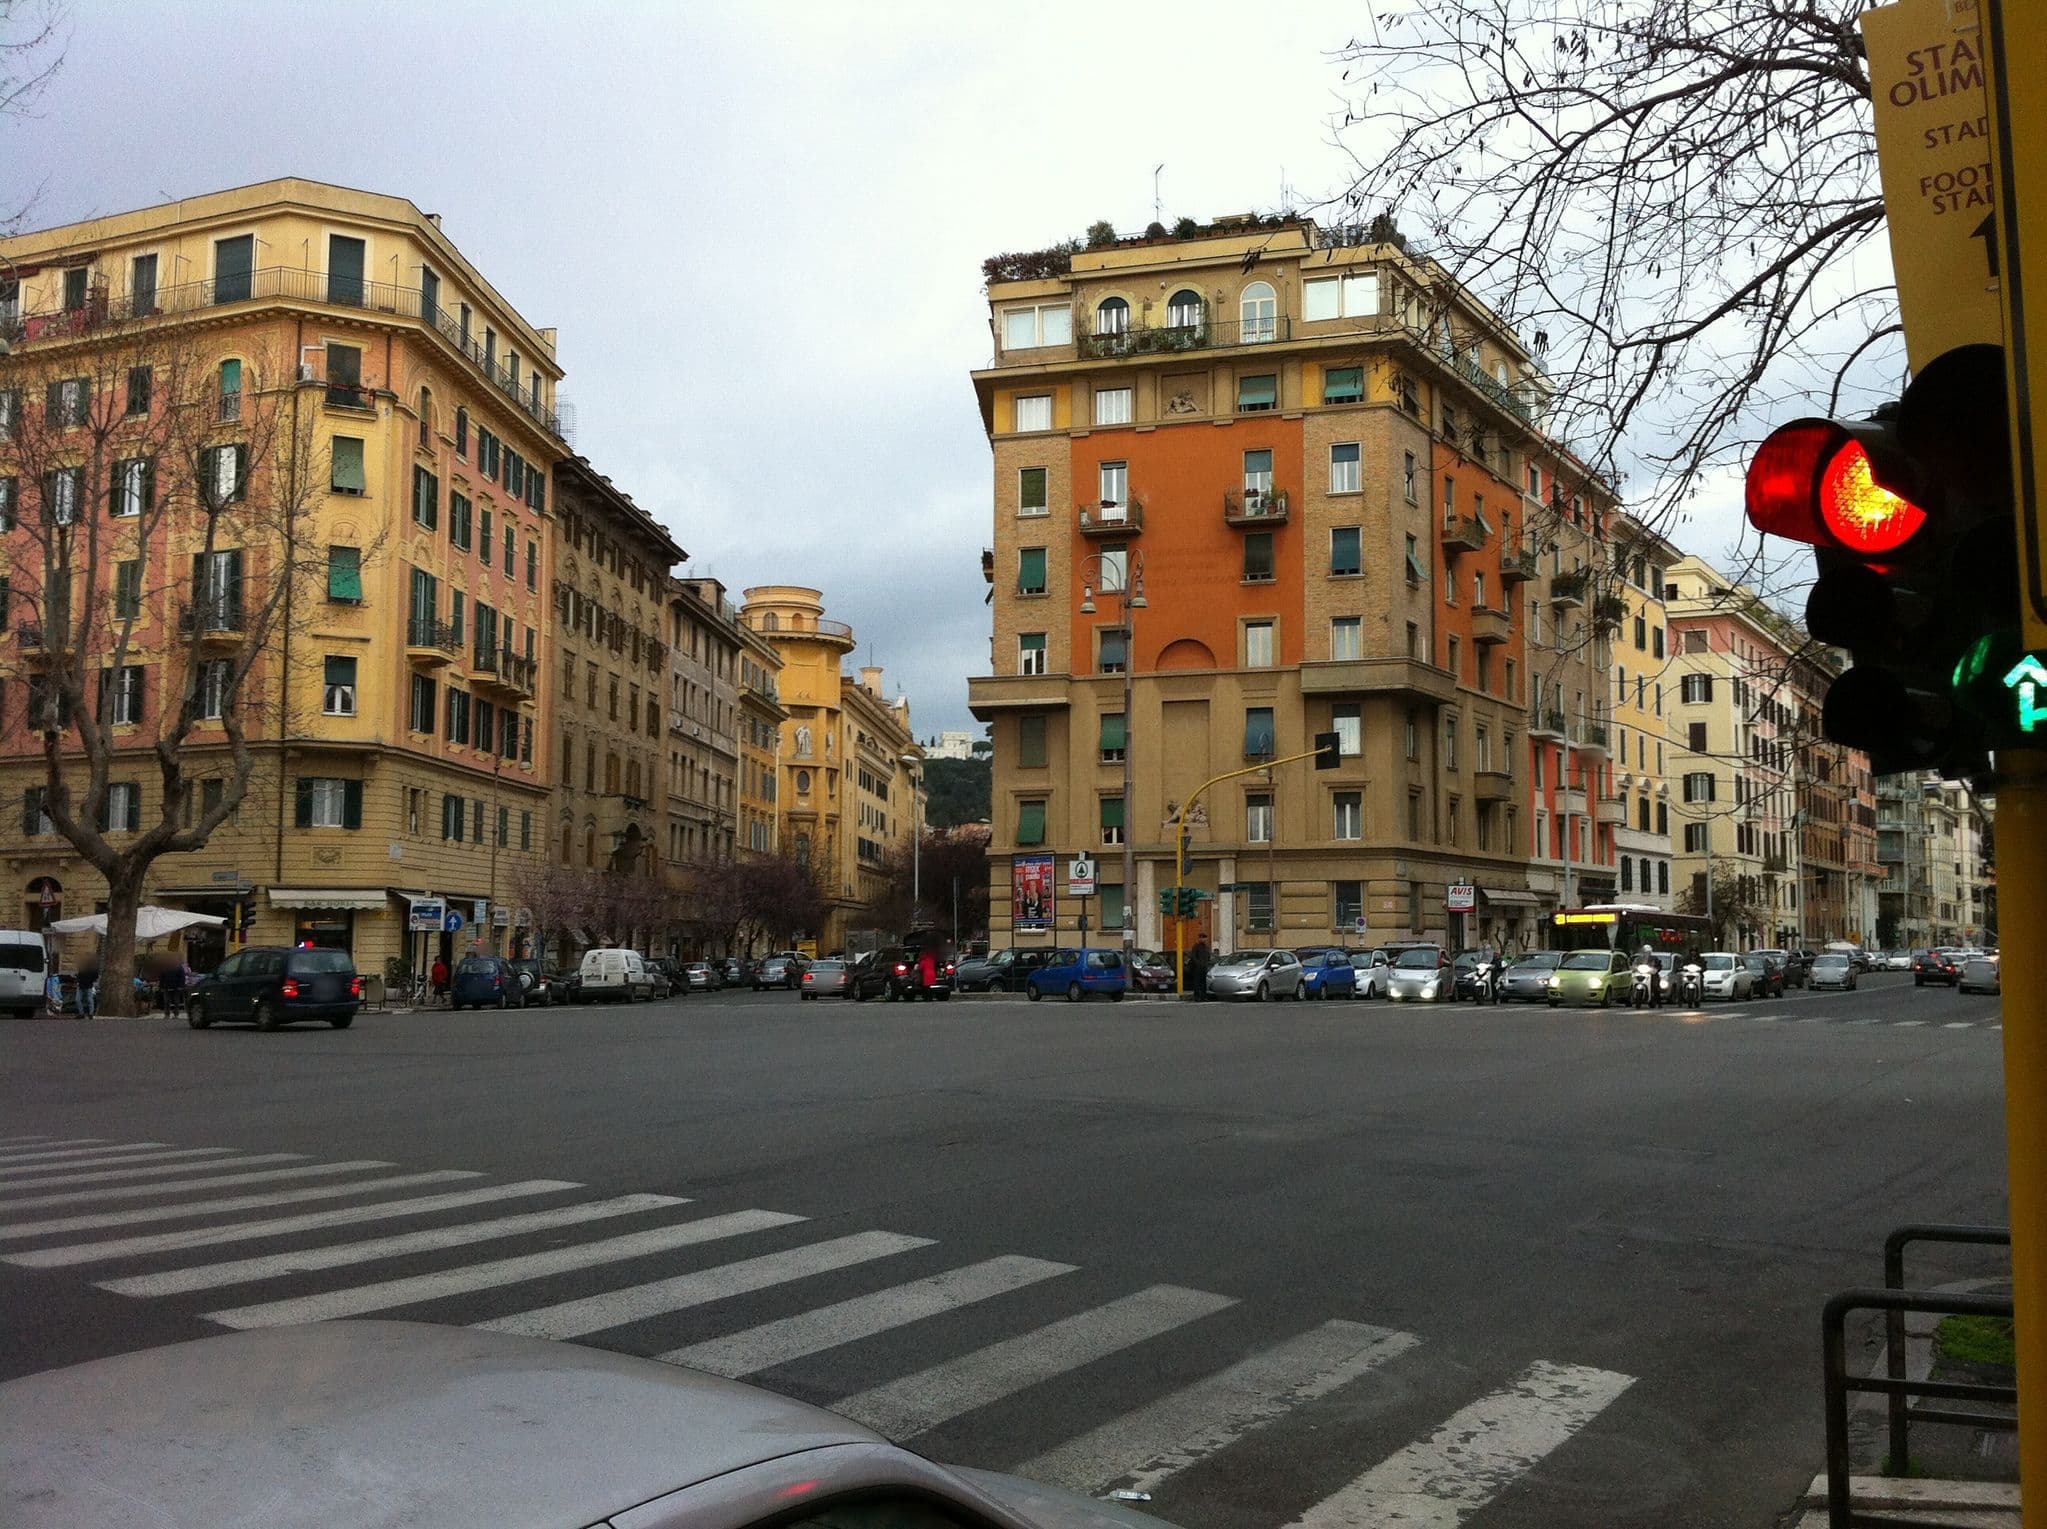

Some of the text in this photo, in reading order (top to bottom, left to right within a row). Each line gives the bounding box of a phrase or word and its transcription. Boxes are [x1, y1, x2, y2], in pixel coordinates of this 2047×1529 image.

[1889, 62, 1983, 107] OLIM
[1920, 162, 1994, 197] FOOT
[1451, 887, 1473, 896] AVIS
